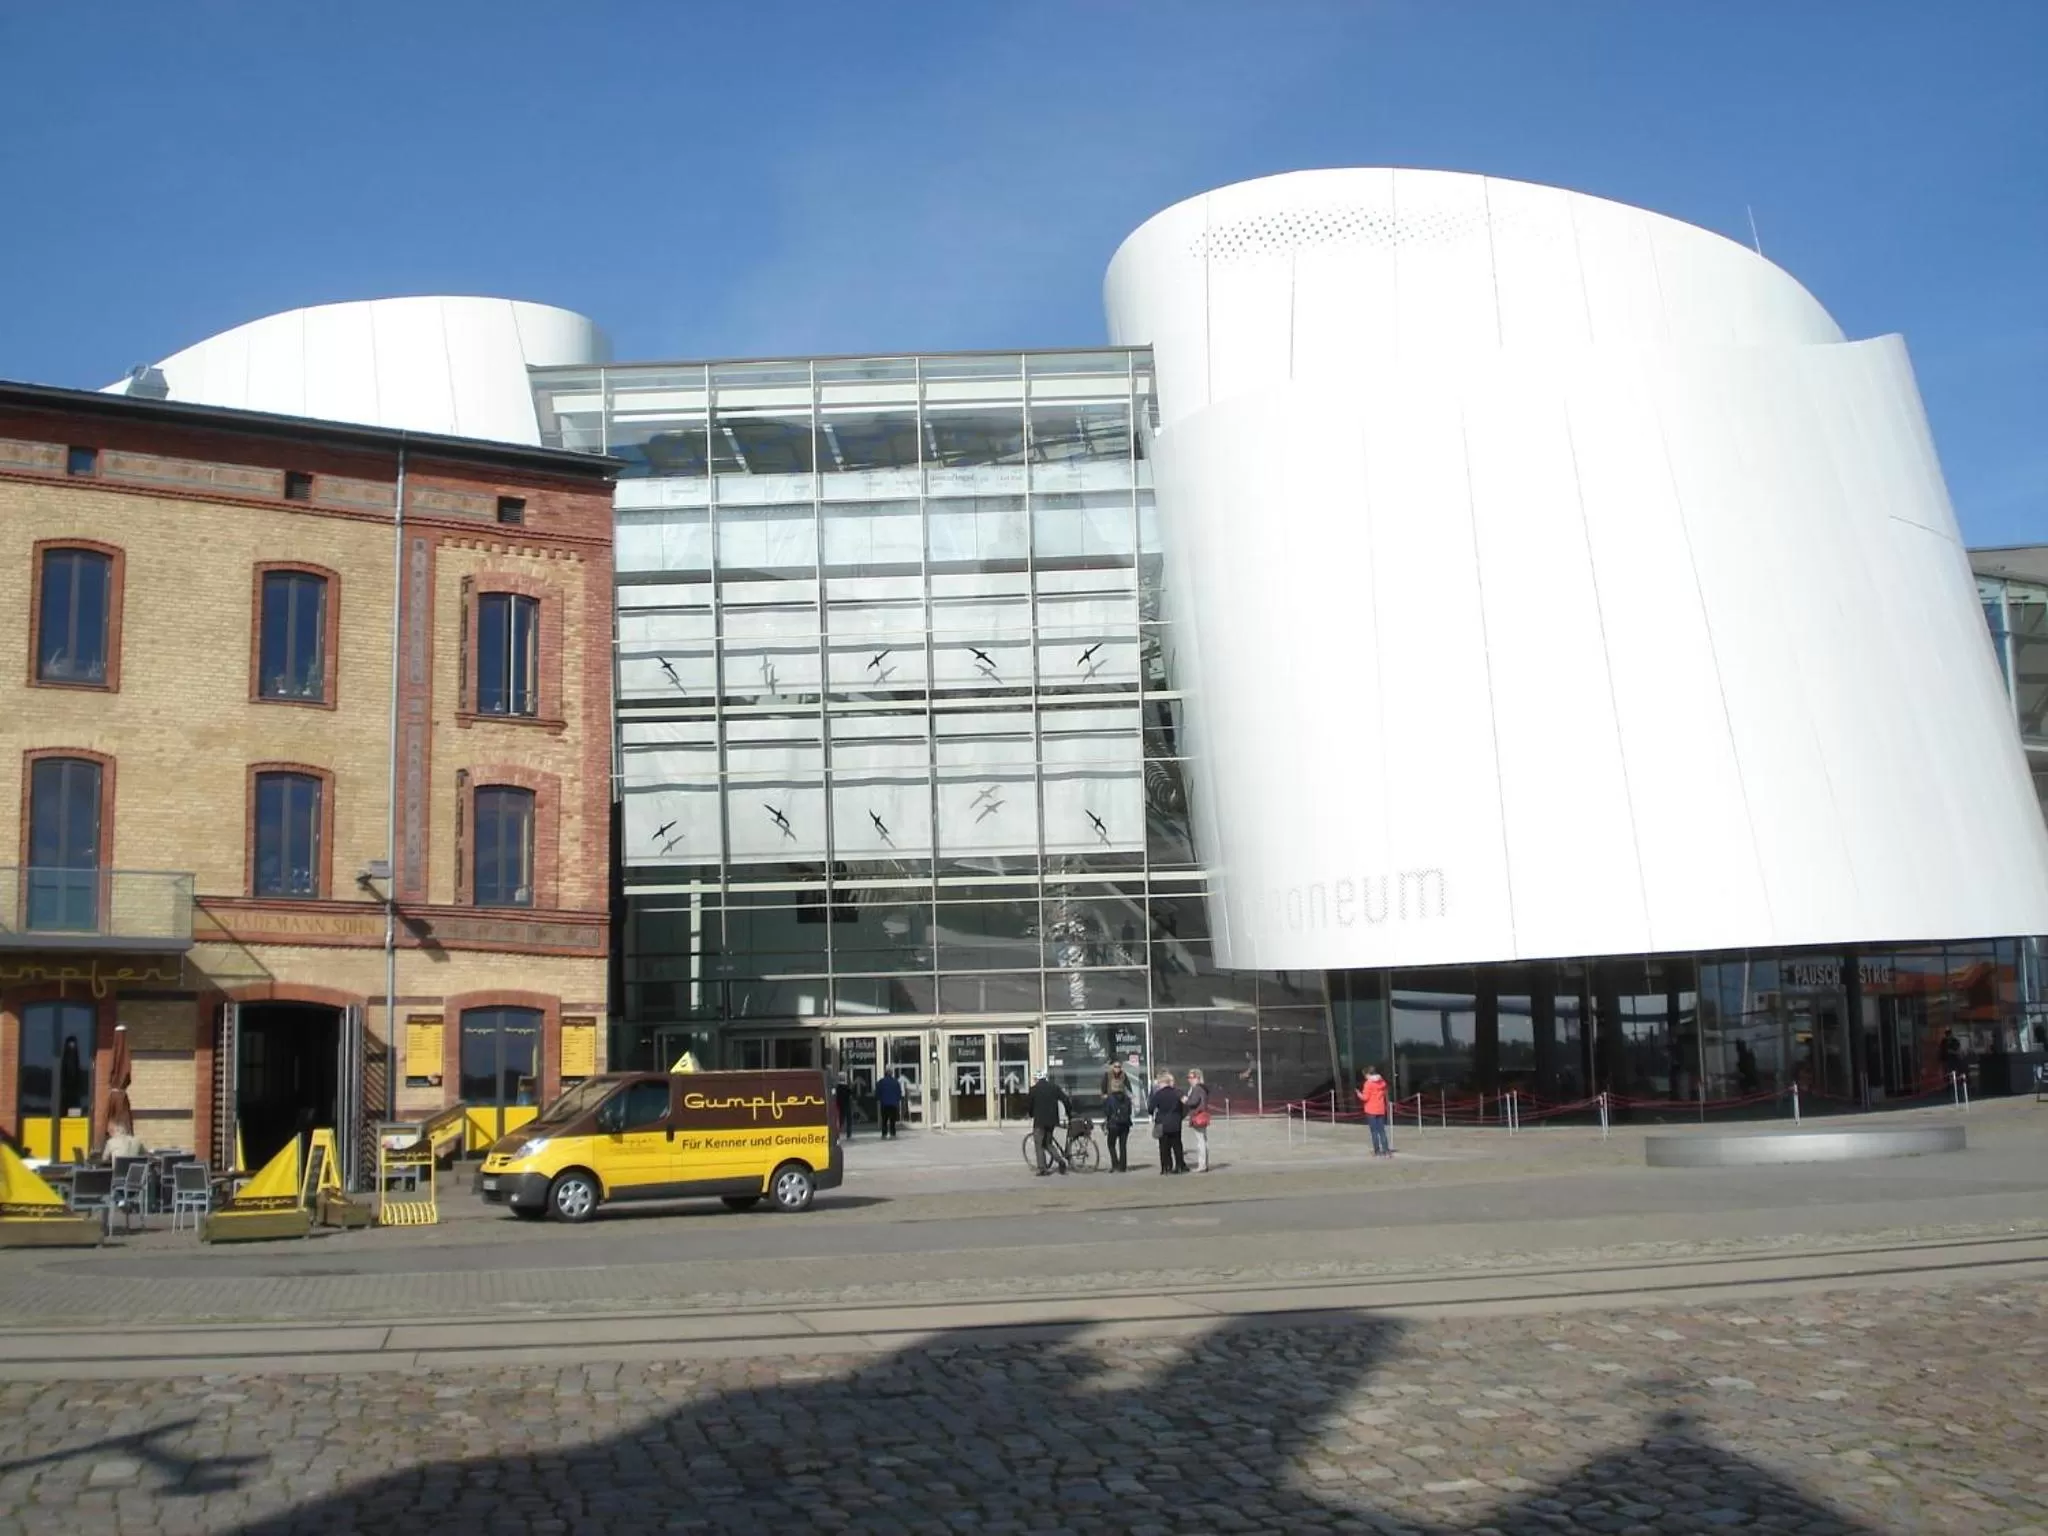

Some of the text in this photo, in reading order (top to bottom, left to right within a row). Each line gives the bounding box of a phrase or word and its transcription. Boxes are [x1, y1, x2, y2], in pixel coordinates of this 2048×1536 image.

[684, 1090, 825, 1121] Gumpfer
[682, 1139, 702, 1150] Für
[705, 1137, 747, 1149] Kenner
[750, 1134, 772, 1147] und
